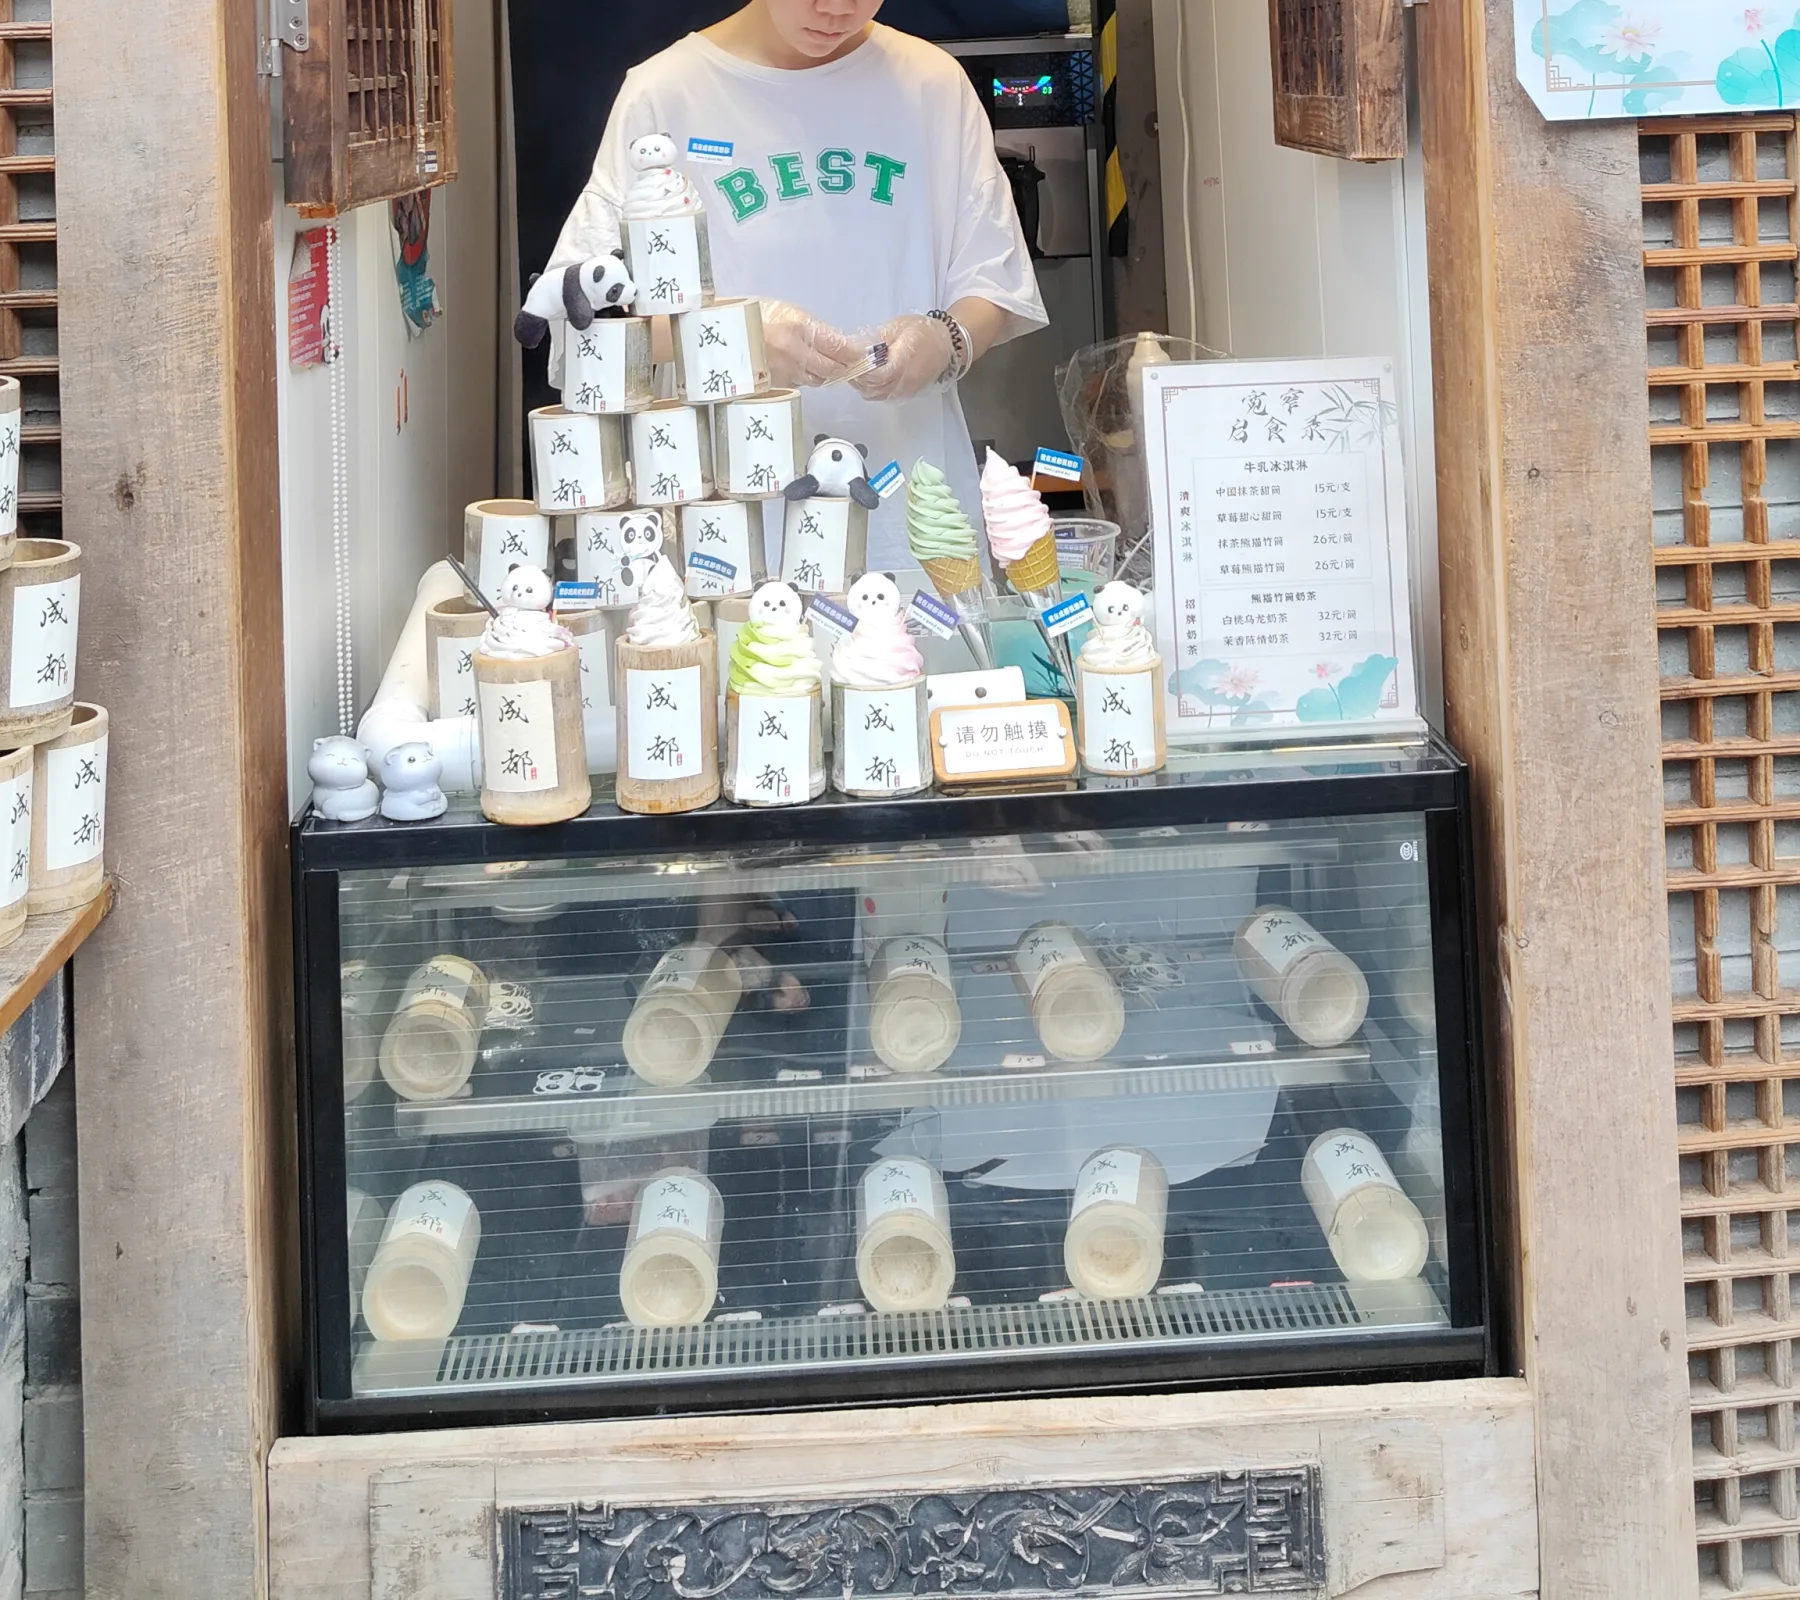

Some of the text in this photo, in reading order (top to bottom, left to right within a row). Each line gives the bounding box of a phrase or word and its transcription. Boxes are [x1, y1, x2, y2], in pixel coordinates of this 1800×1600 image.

[714, 147, 907, 224] BEST
[647, 229, 680, 304] 成都
[576, 334, 603, 411] 成都
[698, 324, 732, 398] 成都
[551, 429, 582, 506] 成都
[649, 424, 680, 501] 成都
[746, 414, 776, 492] 成都
[1215, 481, 1352, 498] 中国抹茶甜筒 15元/支
[1243, 459, 1308, 474] 牛乳冰淇淋
[794, 510, 824, 589] 成都
[1179, 491, 1194, 563] 清爽冰淇淋
[1216, 507, 1353, 524] 草莓甜心甜筒 15元/支
[1217, 532, 1354, 549] 抹茶熊猫竹筒 26元/筒
[1219, 558, 1355, 575] 草莓熊猫竹筒 26元/筒
[1251, 590, 1317, 605] 熊猫竹筒奶茶
[37, 593, 68, 688] 成都
[1185, 598, 1199, 657] 招牌奶茶
[1222, 608, 1357, 626] 白桃乌龙奶茶 32元/筒
[1223, 629, 1358, 647] 茉香陈情奶茶 32元/筒
[499, 695, 534, 780] 成都
[646, 681, 679, 766] 成都
[755, 710, 788, 797] 成都
[864, 704, 897, 787] 成都
[956, 720, 1048, 745] 请勿触摸
[1102, 687, 1134, 770] 成都
